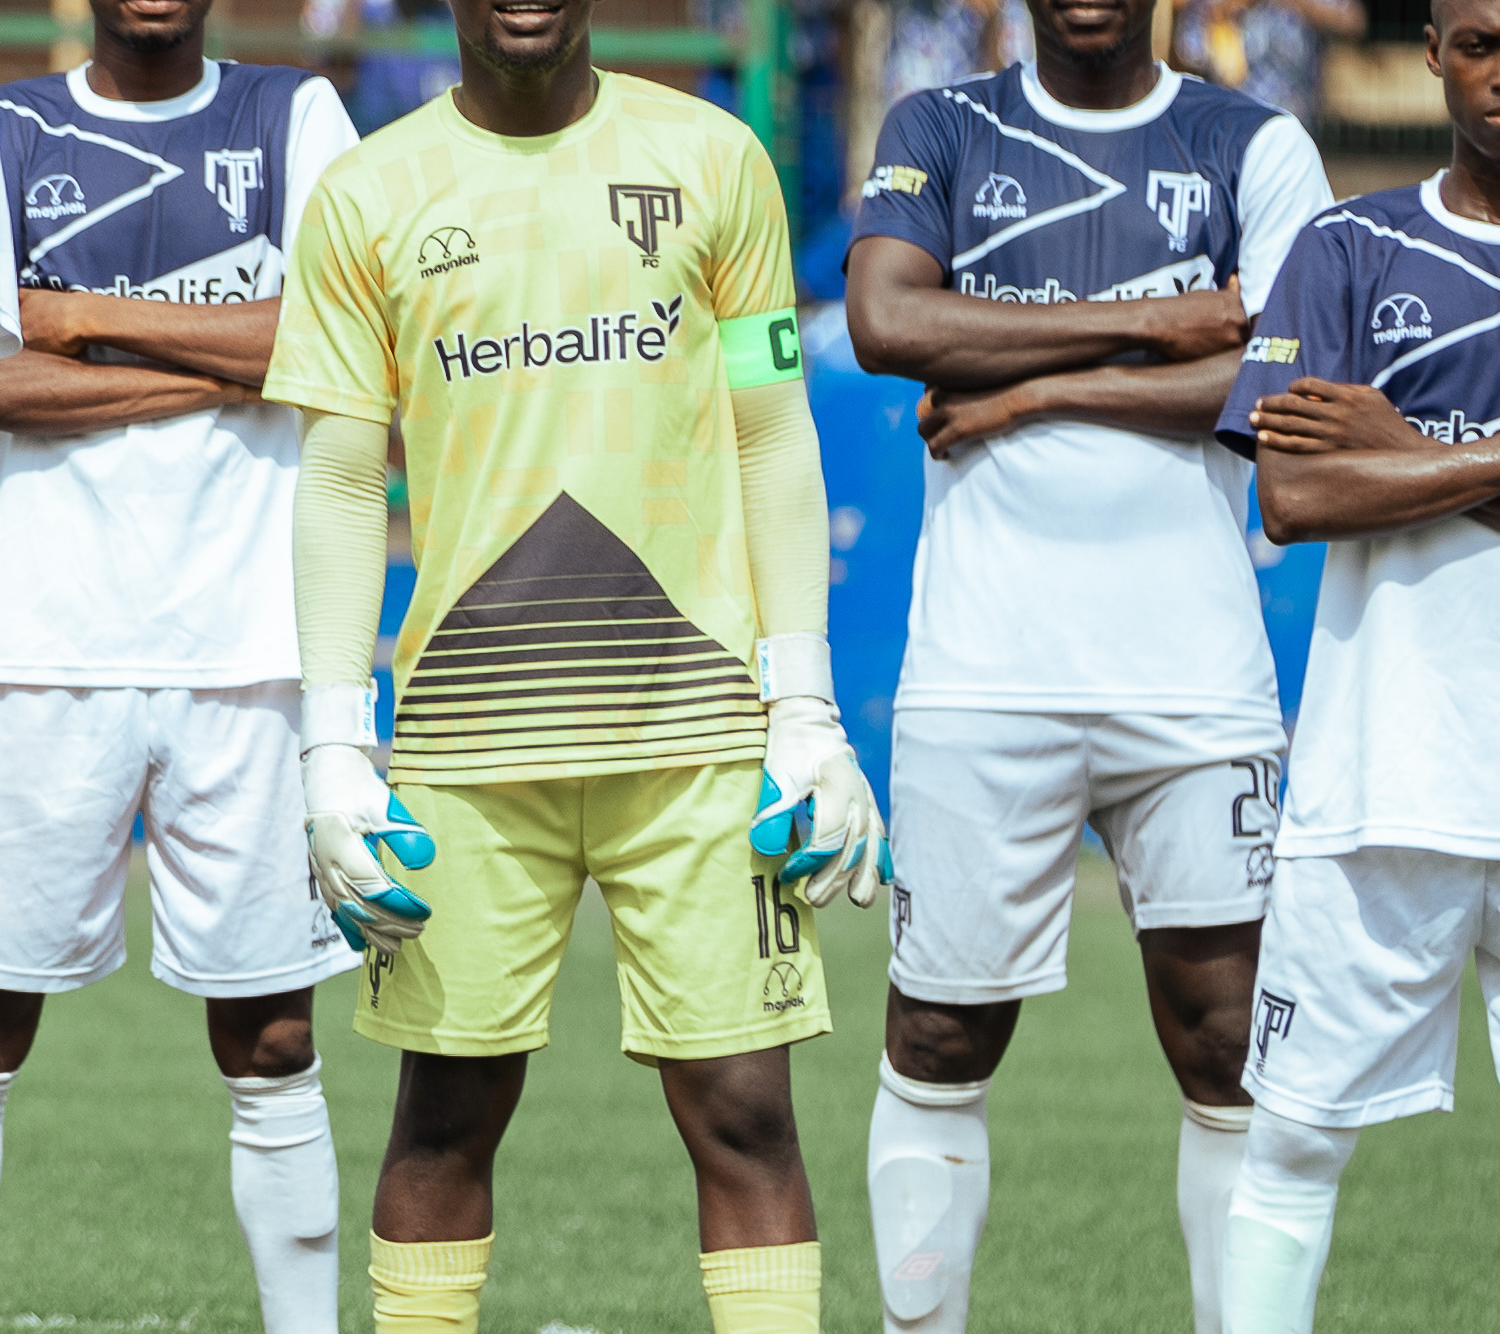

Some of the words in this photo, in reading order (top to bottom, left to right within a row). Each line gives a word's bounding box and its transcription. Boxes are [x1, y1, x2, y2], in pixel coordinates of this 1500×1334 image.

[420, 252, 481, 280] mayniak
[642, 259, 659, 268] FC
[434, 313, 667, 383] Herbalife
[769, 317, 799, 371] C
[752, 873, 800, 959] 16
